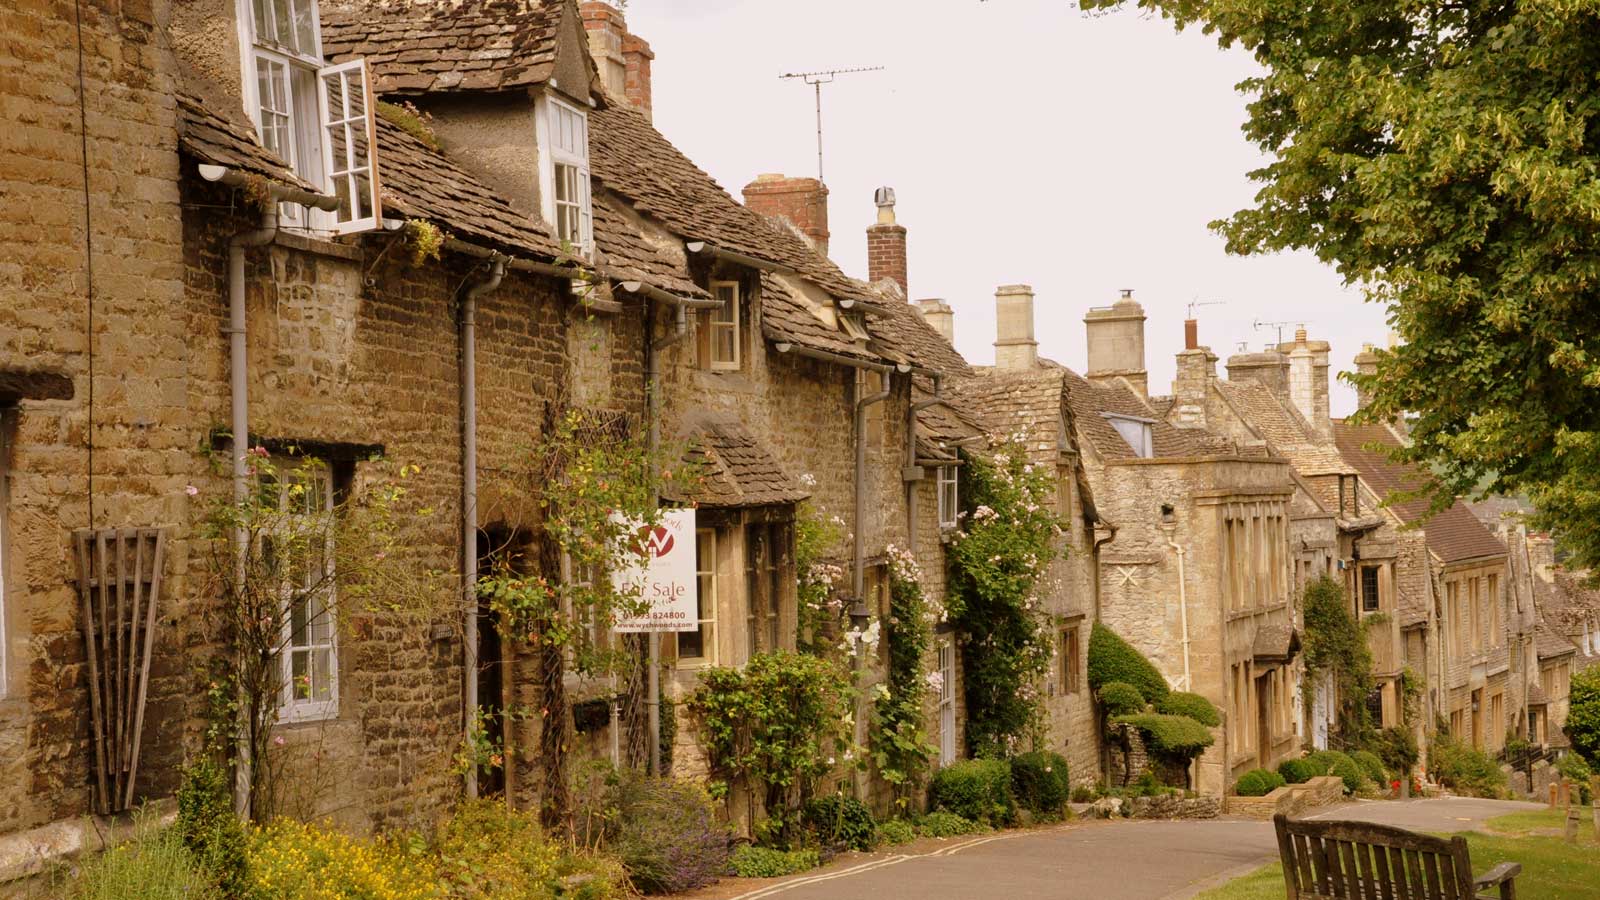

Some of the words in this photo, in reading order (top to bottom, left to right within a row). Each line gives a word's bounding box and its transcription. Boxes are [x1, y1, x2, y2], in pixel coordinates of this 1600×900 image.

[652, 581, 685, 597] Sale
[652, 611, 686, 620] 824800
[617, 621, 693, 630] www.wychwoods.com
